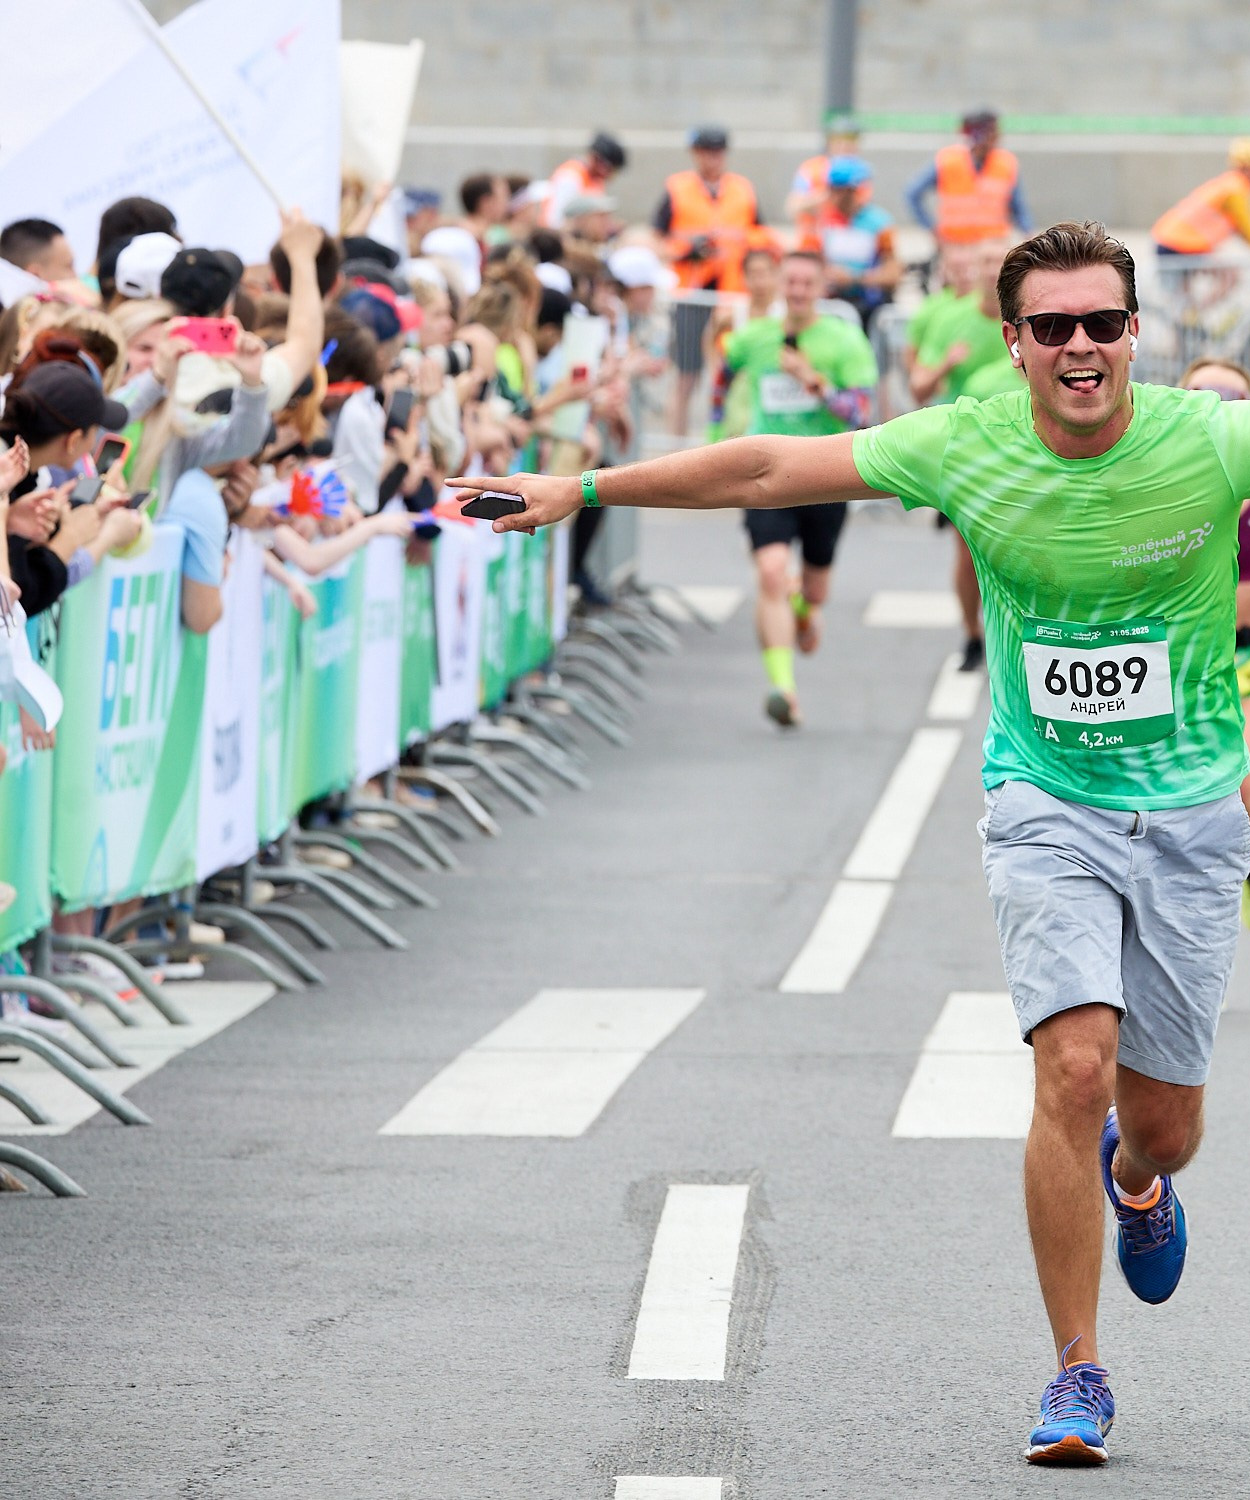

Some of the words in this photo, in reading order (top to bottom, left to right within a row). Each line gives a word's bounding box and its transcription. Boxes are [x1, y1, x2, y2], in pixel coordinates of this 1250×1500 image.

[1120, 530, 1187, 555] зелёный
[1112, 547, 1181, 567] марафон
[1110, 626, 1149, 637] 31.05.2025
[1045, 657, 1148, 698] 6089
[1070, 698, 1126, 715] АНДРЕЙ
